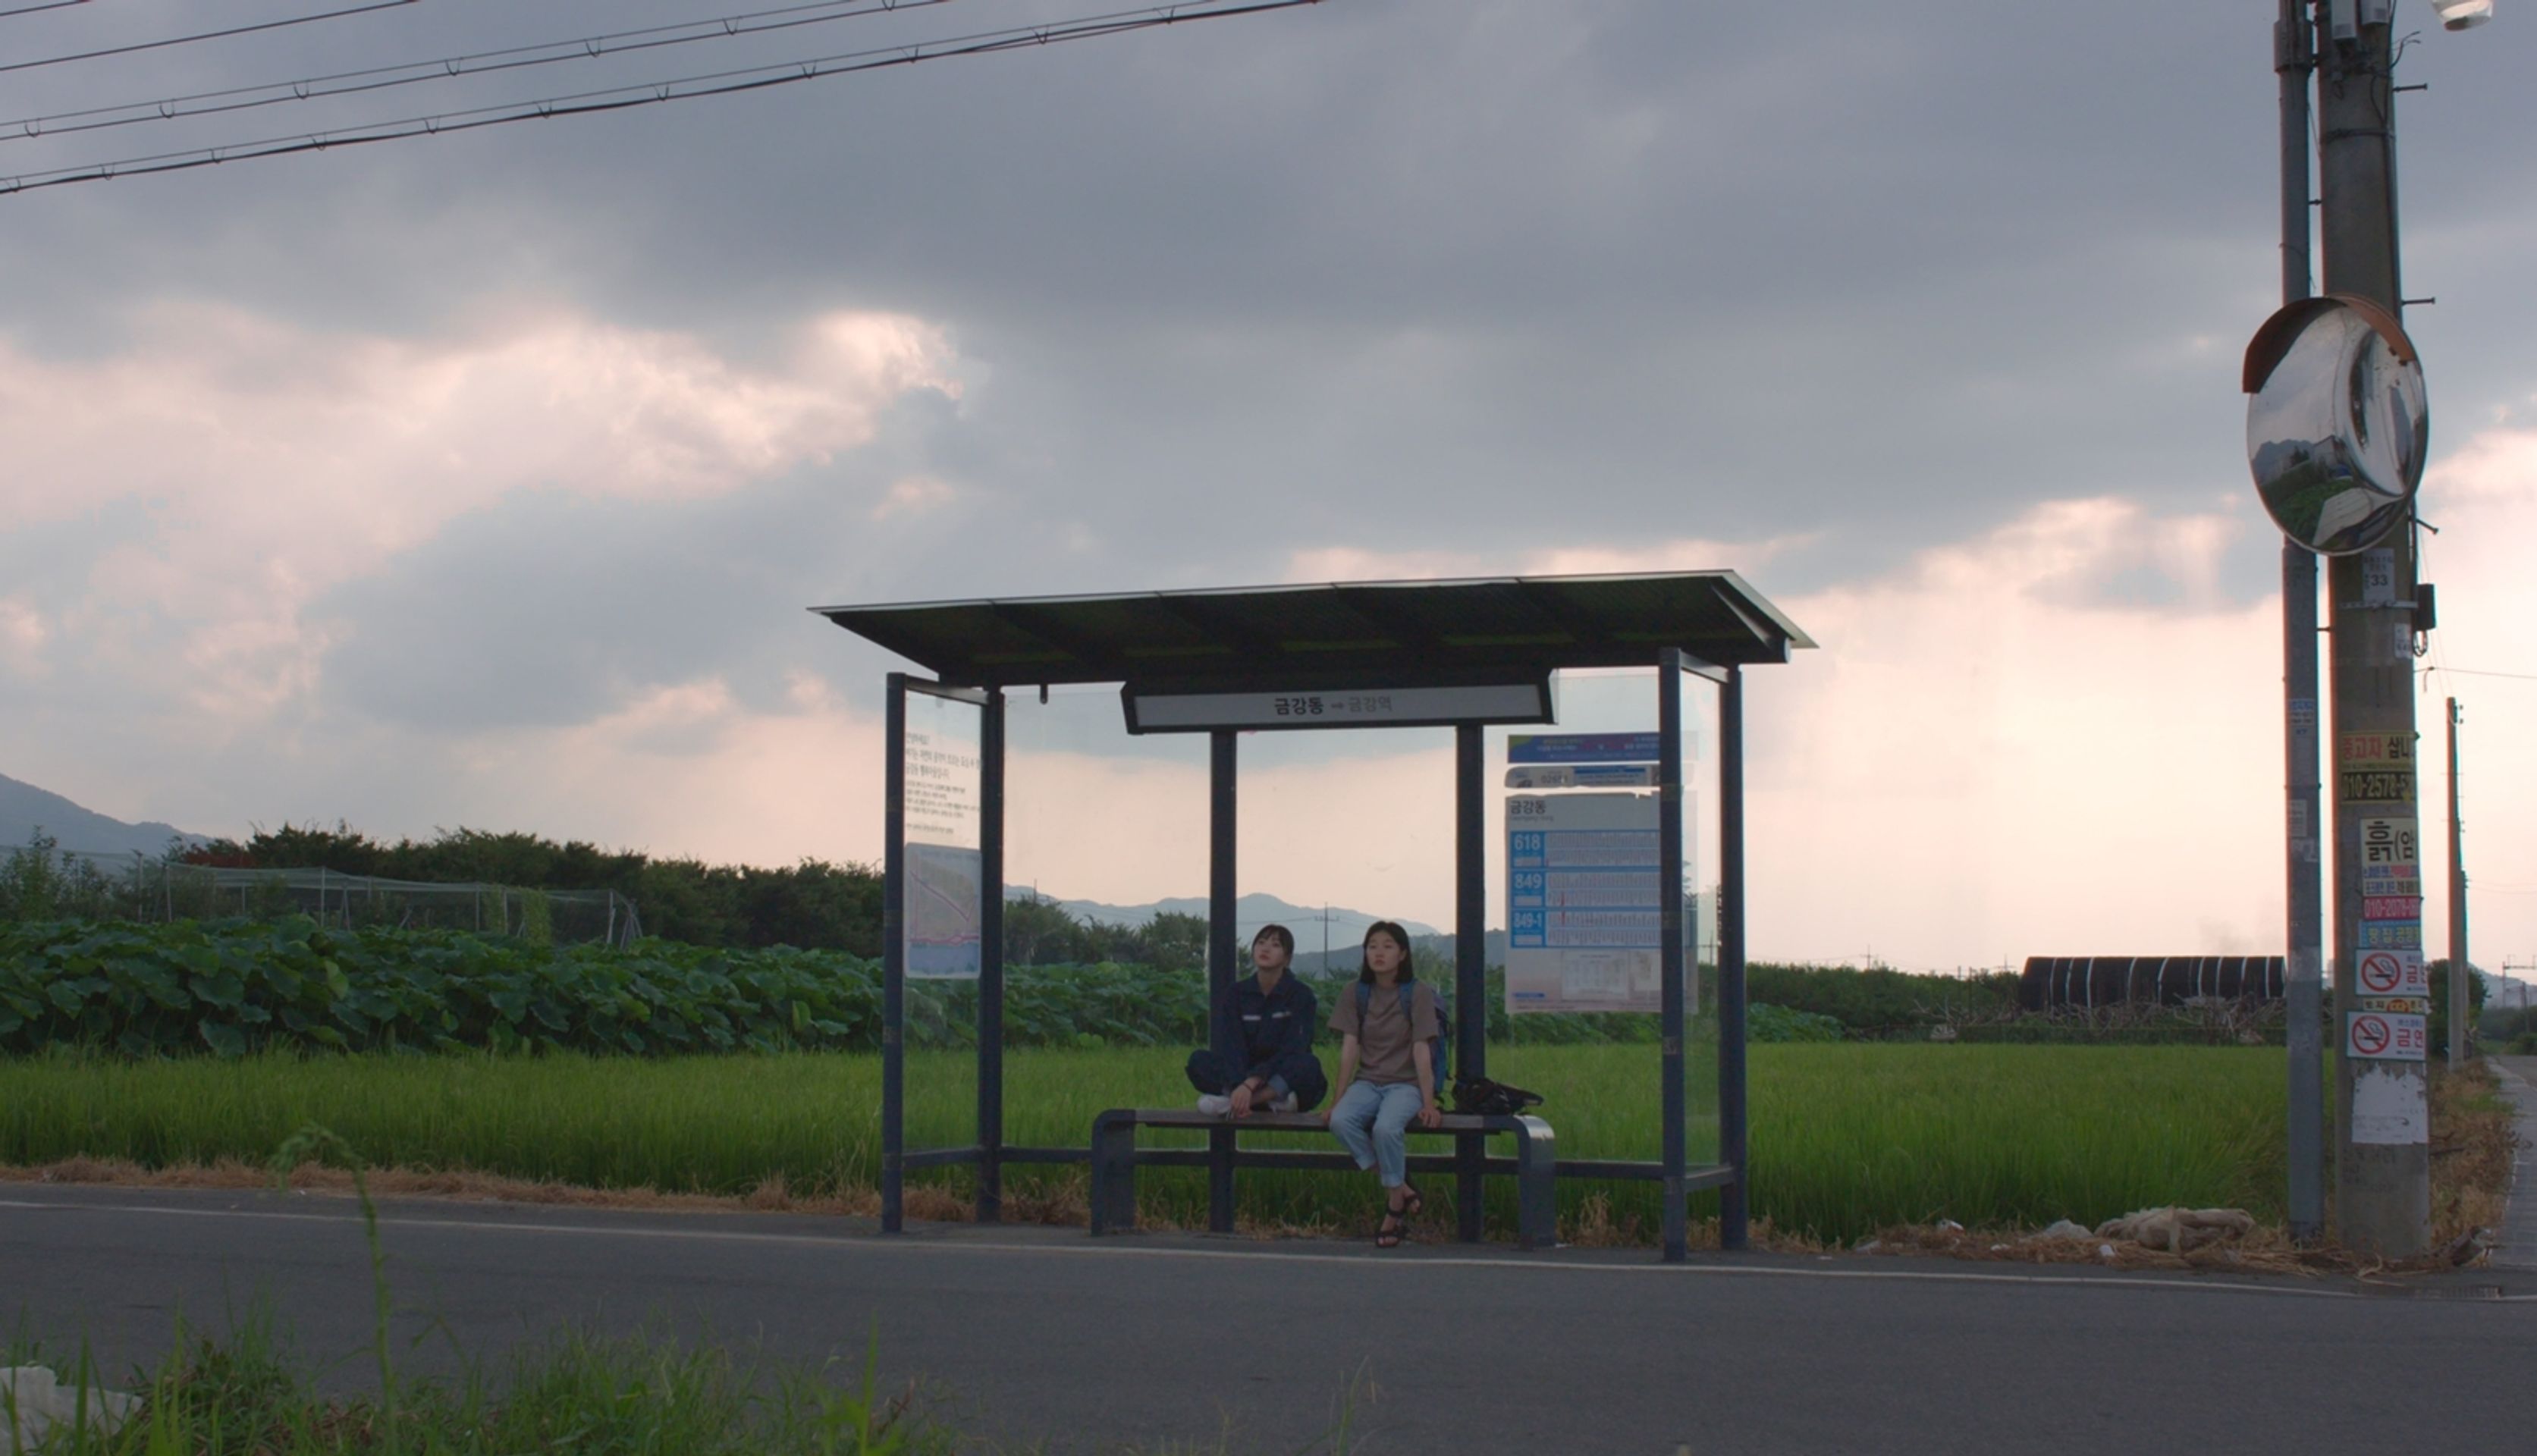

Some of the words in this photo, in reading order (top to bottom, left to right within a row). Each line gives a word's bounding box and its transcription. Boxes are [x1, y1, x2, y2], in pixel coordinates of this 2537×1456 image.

[2371, 574, 2388, 586] 33
[1274, 697, 1324, 715] 금강동
[1348, 695, 1393, 712] 금강역
[2343, 736, 2382, 761] 중고차
[1510, 799, 1546, 814] 금강동
[1514, 833, 1541, 850] 618
[1515, 873, 1542, 889] 849
[1514, 912, 1542, 928] 849-1
